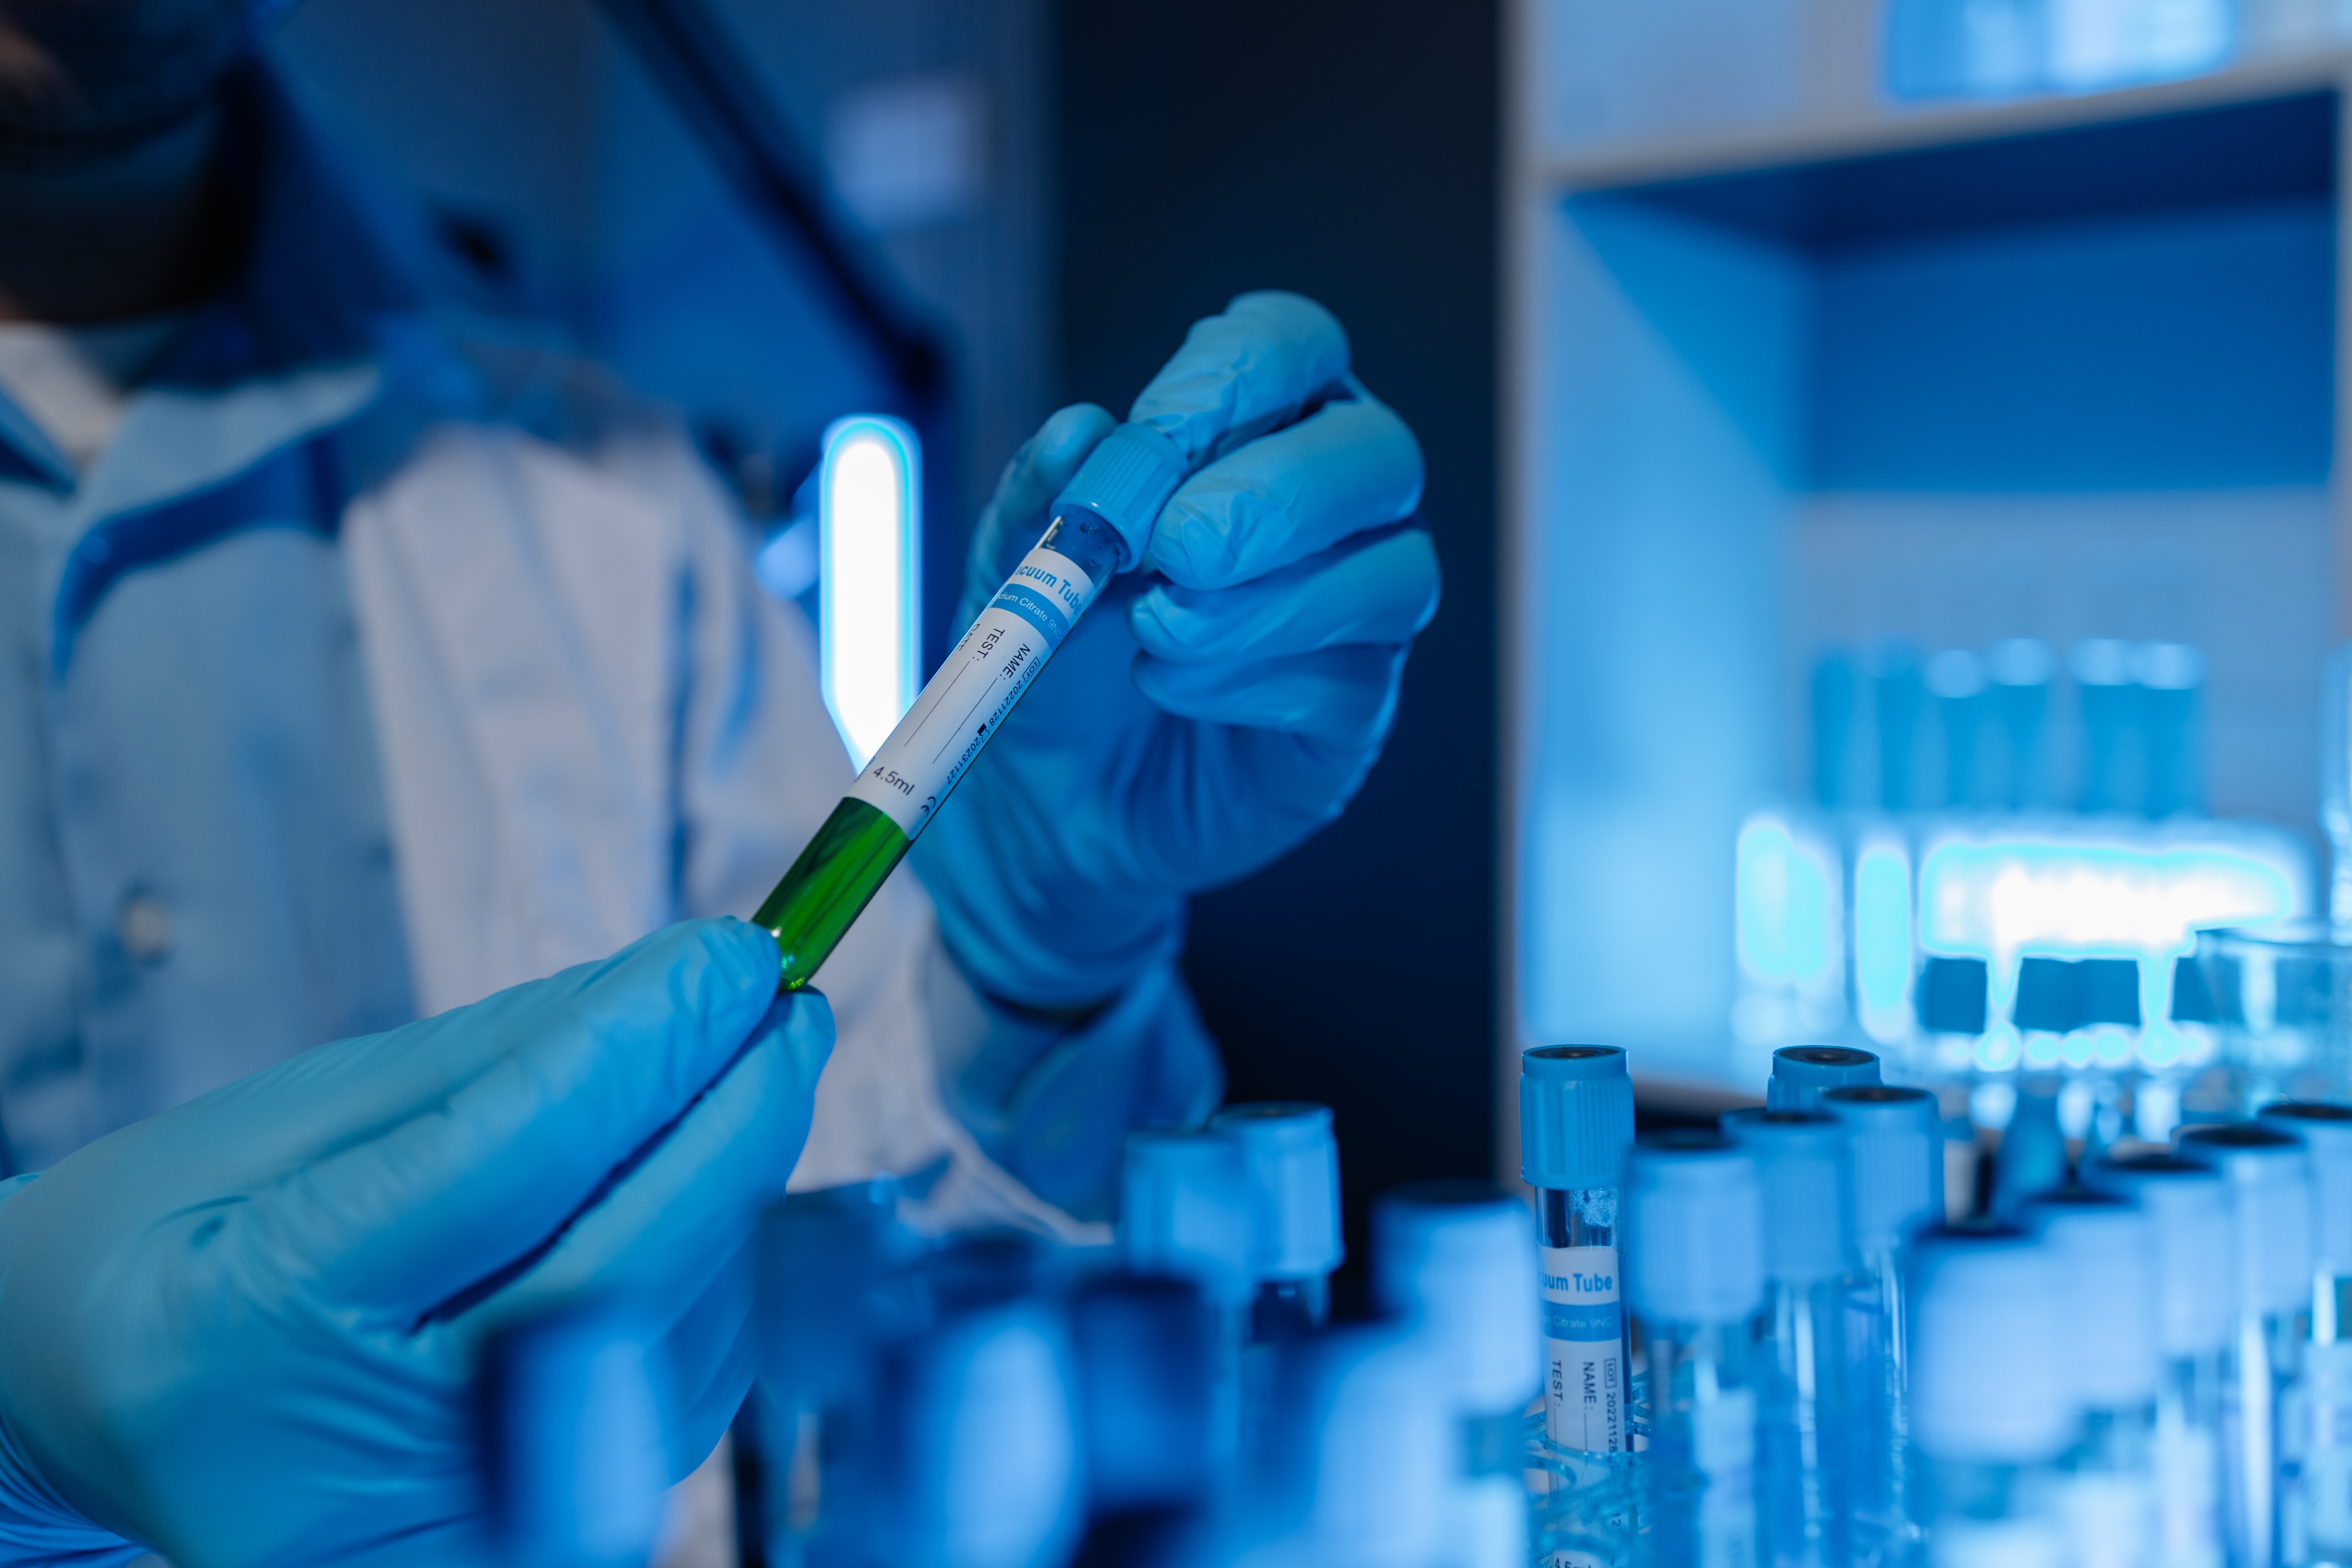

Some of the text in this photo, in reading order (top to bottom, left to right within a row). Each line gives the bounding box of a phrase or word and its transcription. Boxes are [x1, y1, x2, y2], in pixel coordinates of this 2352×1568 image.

[1058, 579, 1082, 615] Tube
[1020, 598, 1047, 621] Citrate
[1048, 619, 1062, 639] 9NC
[972, 628, 1005, 661] TEST:
[1000, 643, 1031, 680] NAME:
[947, 661, 1038, 785] LOT 20221128 20231127
[873, 766, 915, 796] 4.5ml
[1573, 1273, 1612, 1292] Tube
[1553, 1359, 1563, 1407] TEST:
[1583, 1361, 1597, 1410] NAME:
